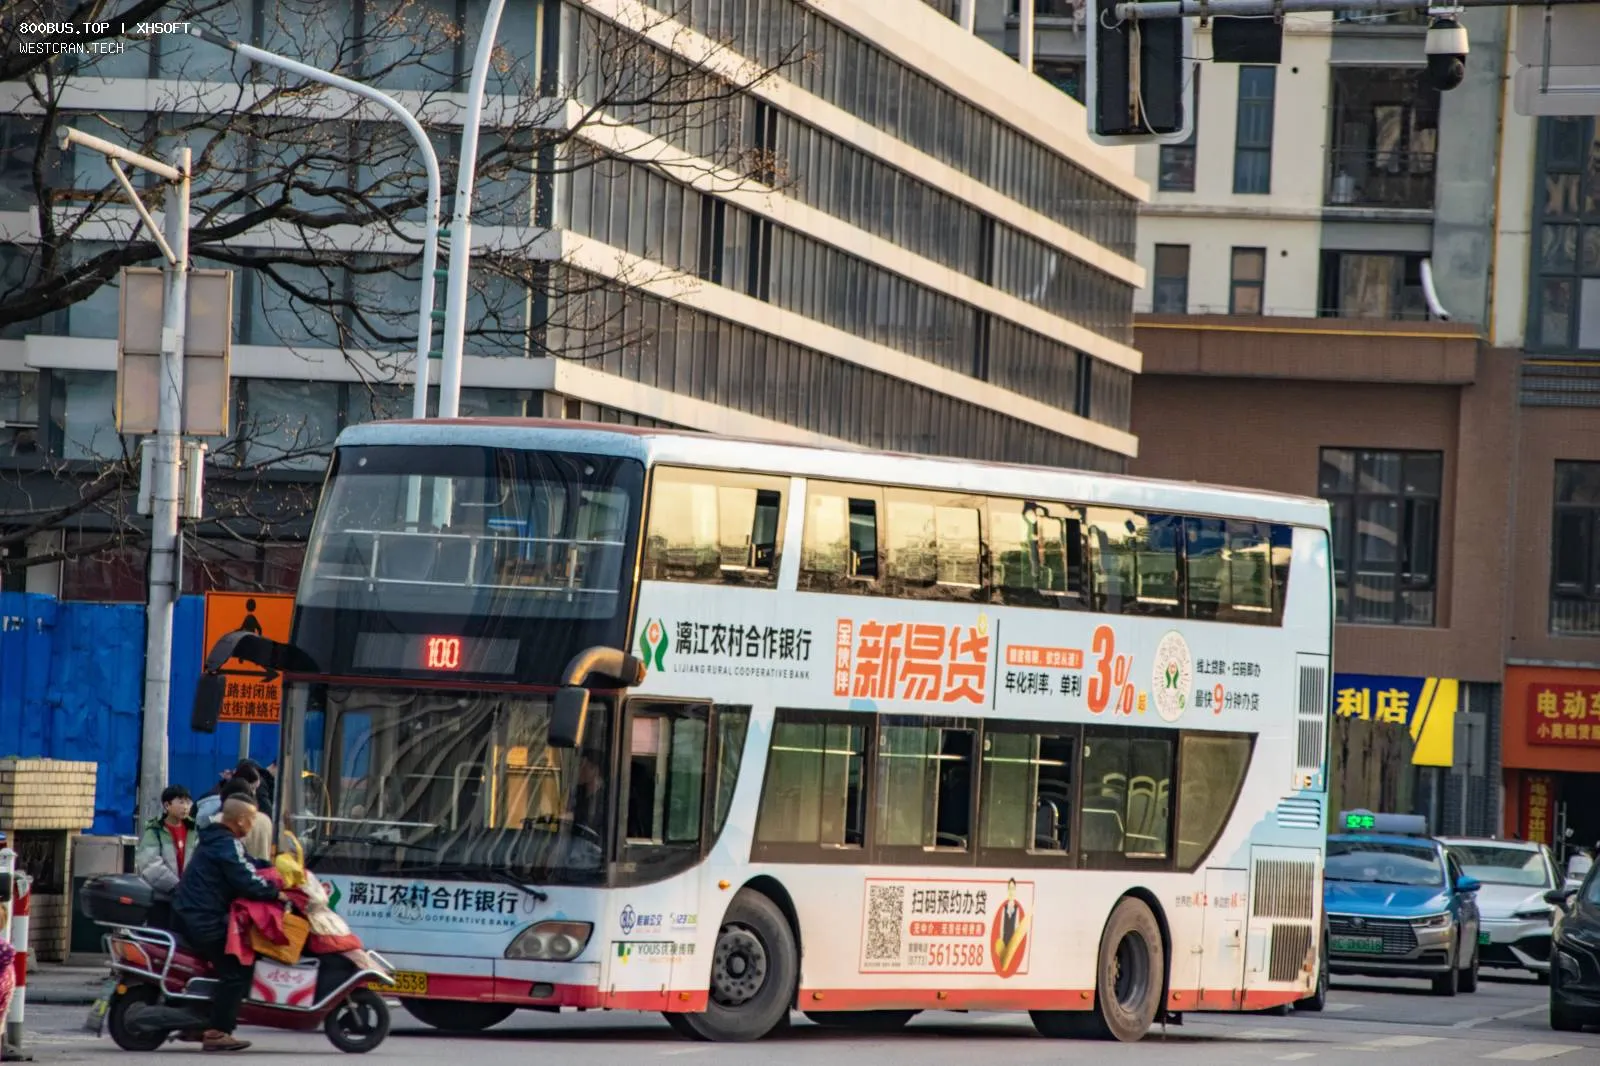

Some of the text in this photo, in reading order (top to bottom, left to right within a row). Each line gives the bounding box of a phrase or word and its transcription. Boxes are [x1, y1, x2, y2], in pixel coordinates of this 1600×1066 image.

[428, 637, 460, 669] 100
[675, 621, 812, 661] 漓江农村合作银行
[789, 669, 810, 680] BANK
[853, 620, 990, 704] 新易贷
[1087, 624, 1134, 715] 3%
[225, 682, 277, 700] 路封闭施
[1335, 687, 1410, 725] 利店
[348, 881, 519, 914] 漓江农村合作银行
[911, 889, 987, 915] 扫码预约办贷
[420, 912, 486, 926] OOPERATIVE
[928, 943, 984, 966] 5615588
